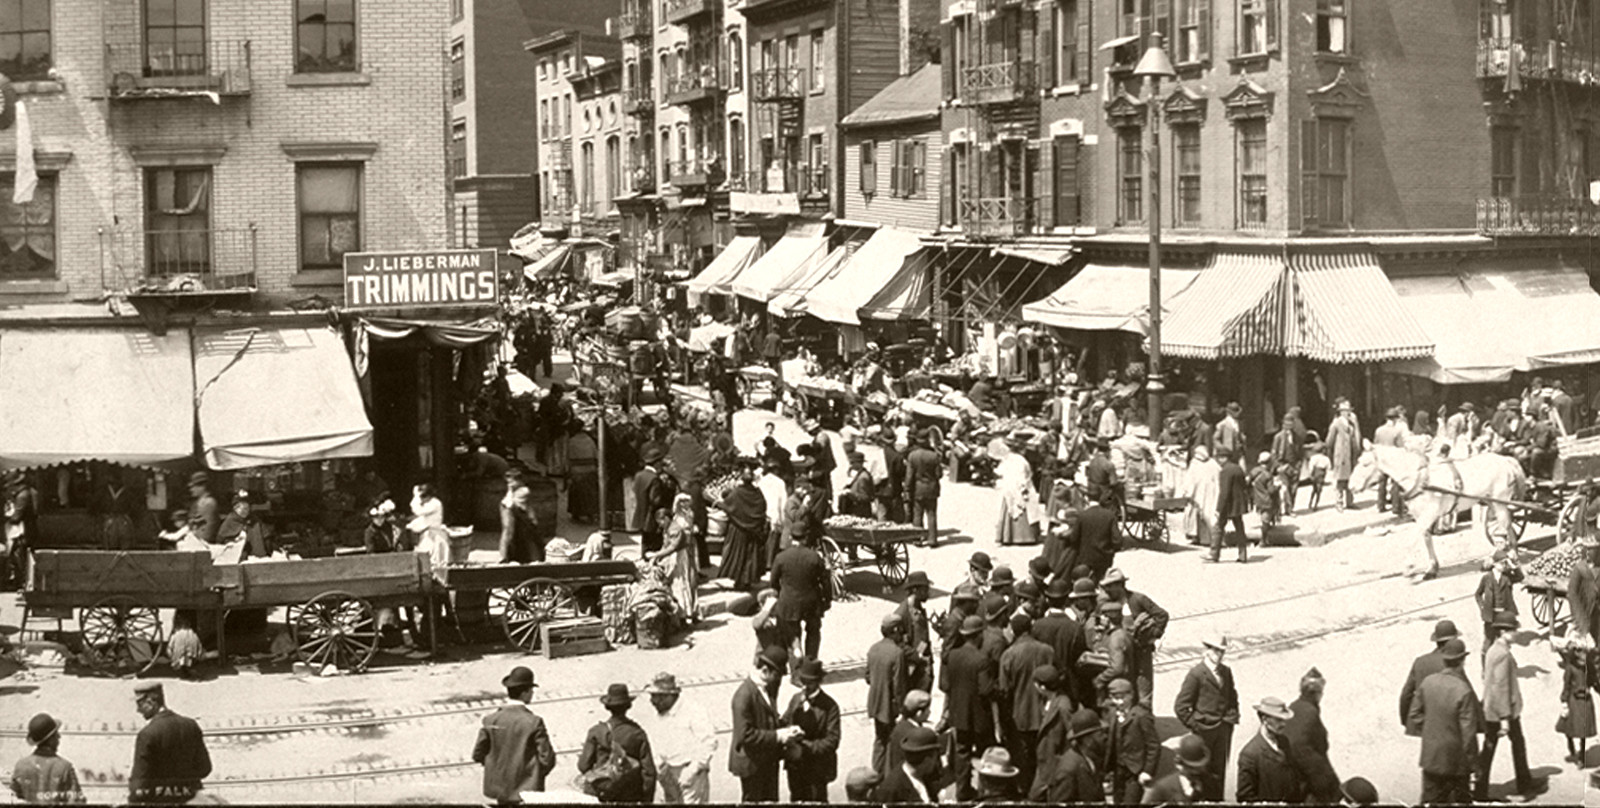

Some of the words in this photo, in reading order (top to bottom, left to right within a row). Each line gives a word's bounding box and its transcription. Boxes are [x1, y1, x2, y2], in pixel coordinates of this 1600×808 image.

[363, 257, 380, 272] J.
[382, 254, 481, 271] LIEBERMAN
[347, 271, 495, 305] TRIMMINGS
